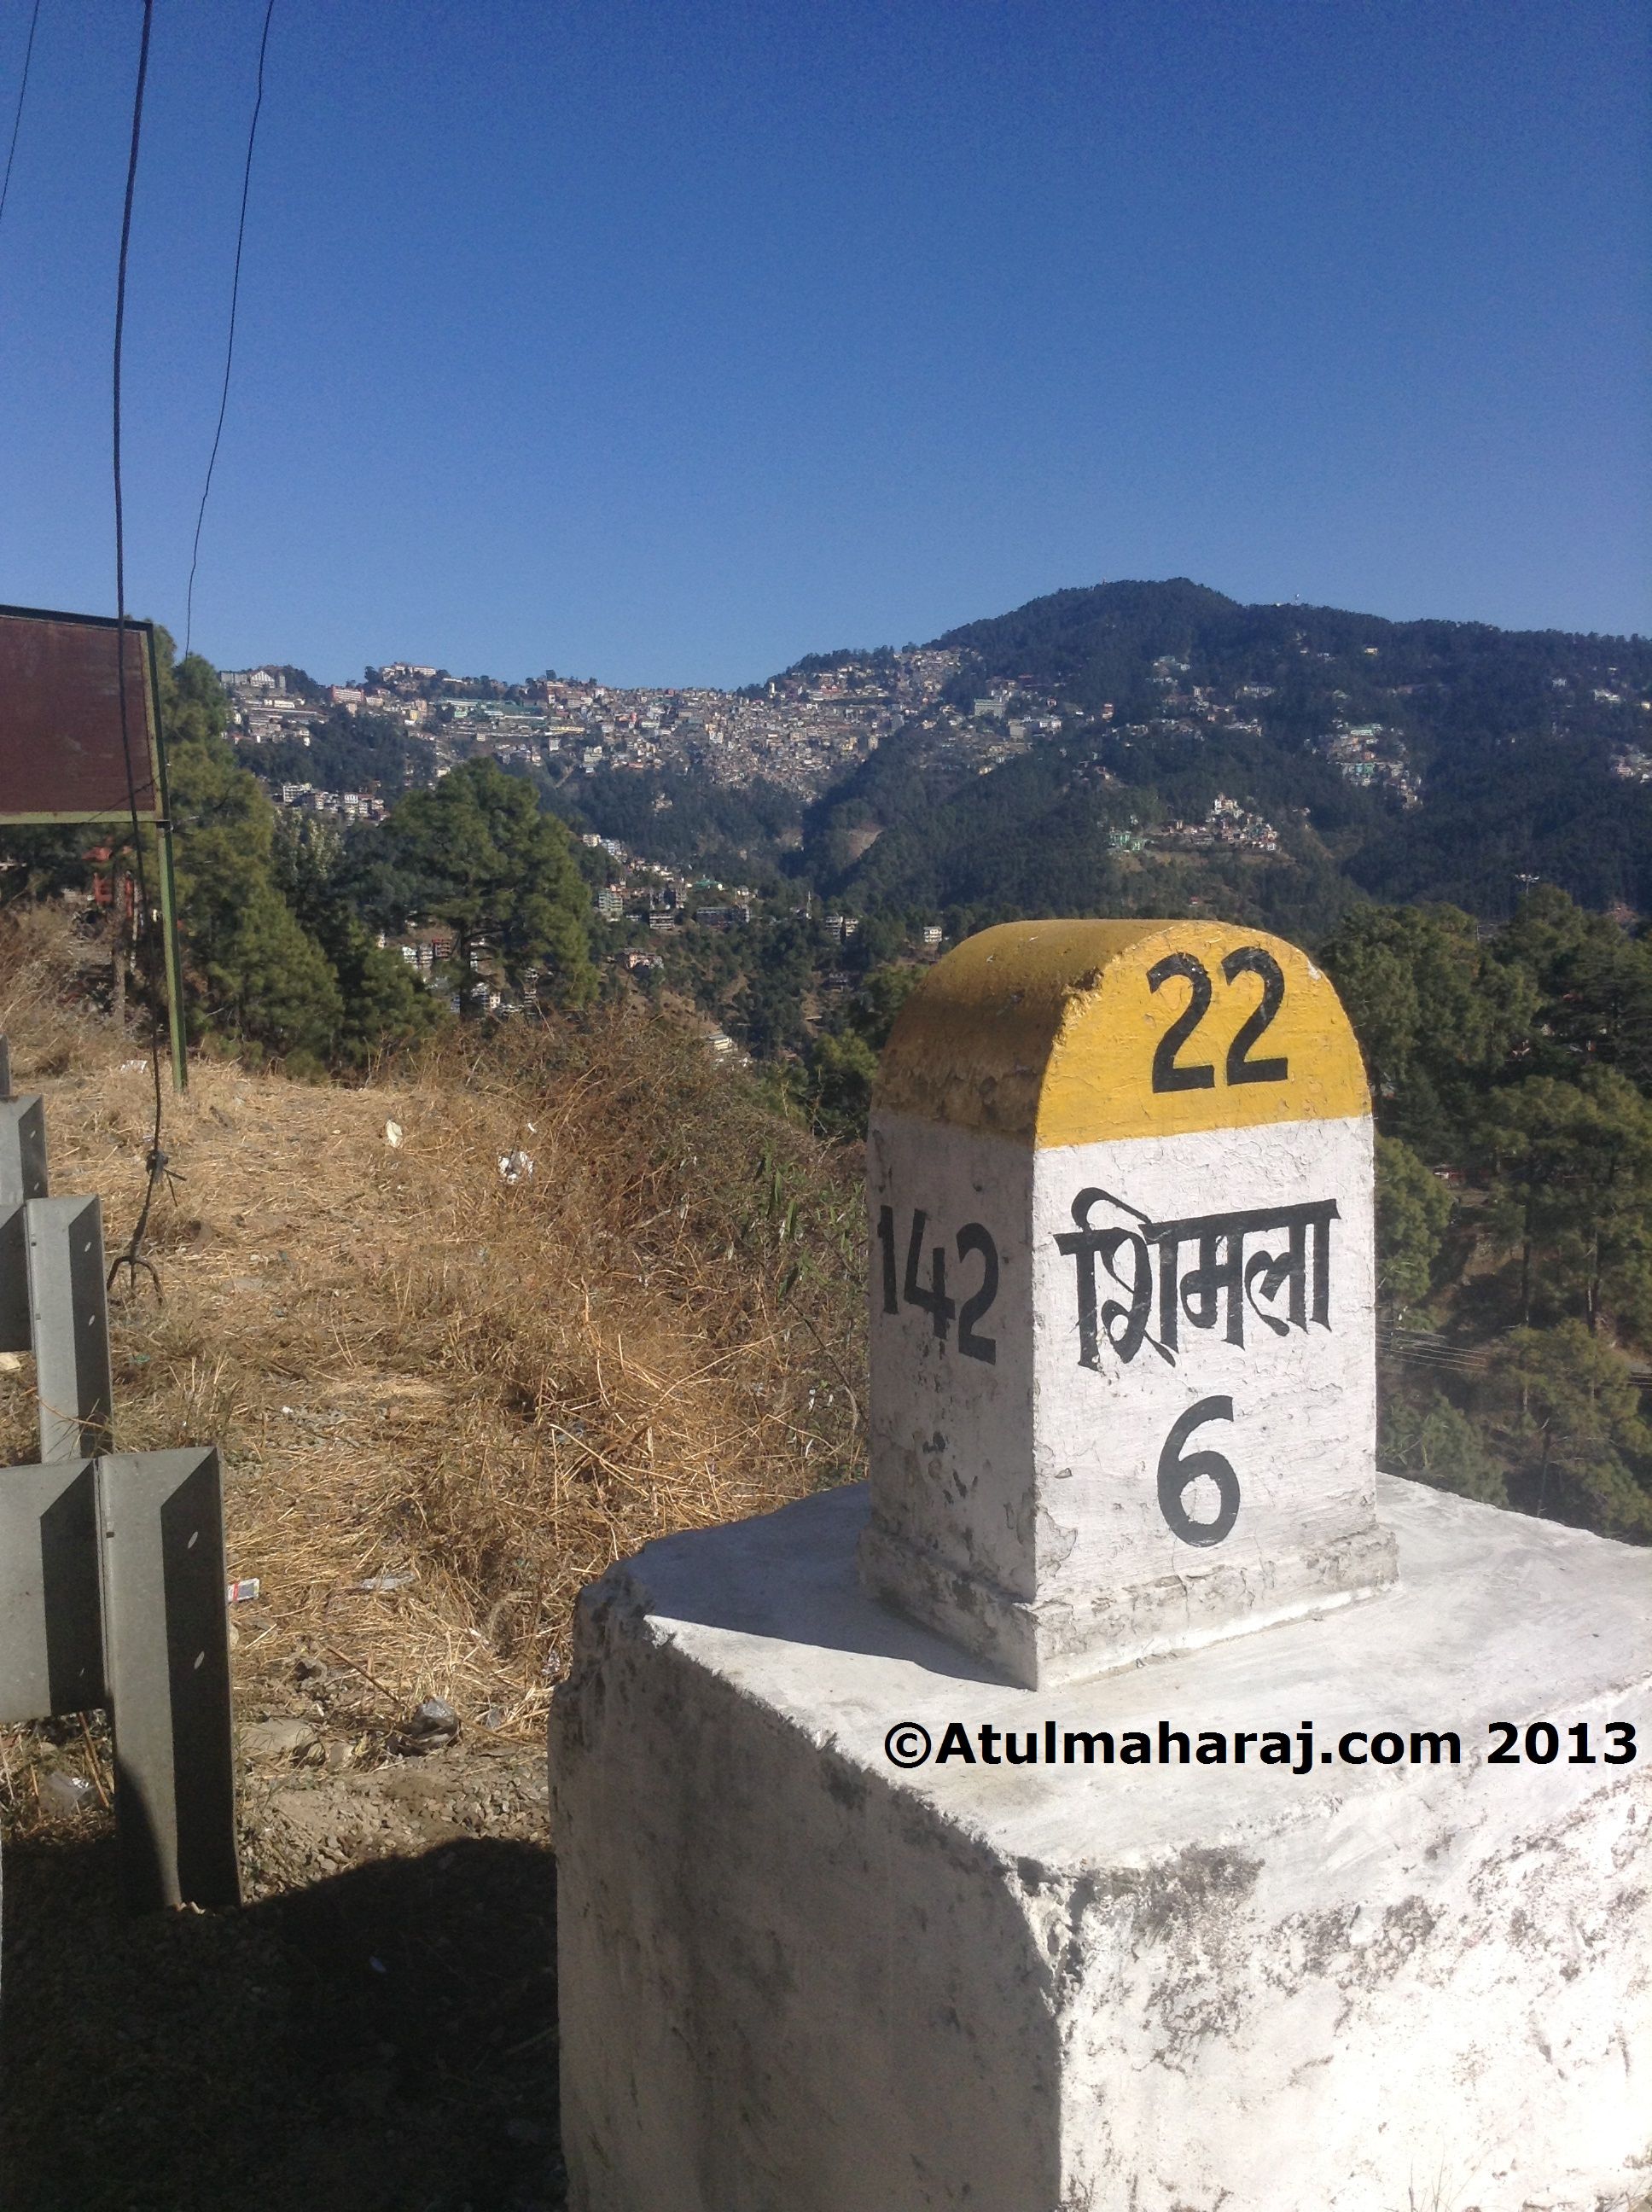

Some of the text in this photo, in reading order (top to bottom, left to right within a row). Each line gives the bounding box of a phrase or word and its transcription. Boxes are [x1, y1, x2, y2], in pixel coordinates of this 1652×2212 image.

[1146, 946, 1288, 1093] 22
[877, 1204, 998, 1365] 142
[1053, 1187, 1341, 1371] शिमला
[1157, 1394, 1241, 1548] 6
